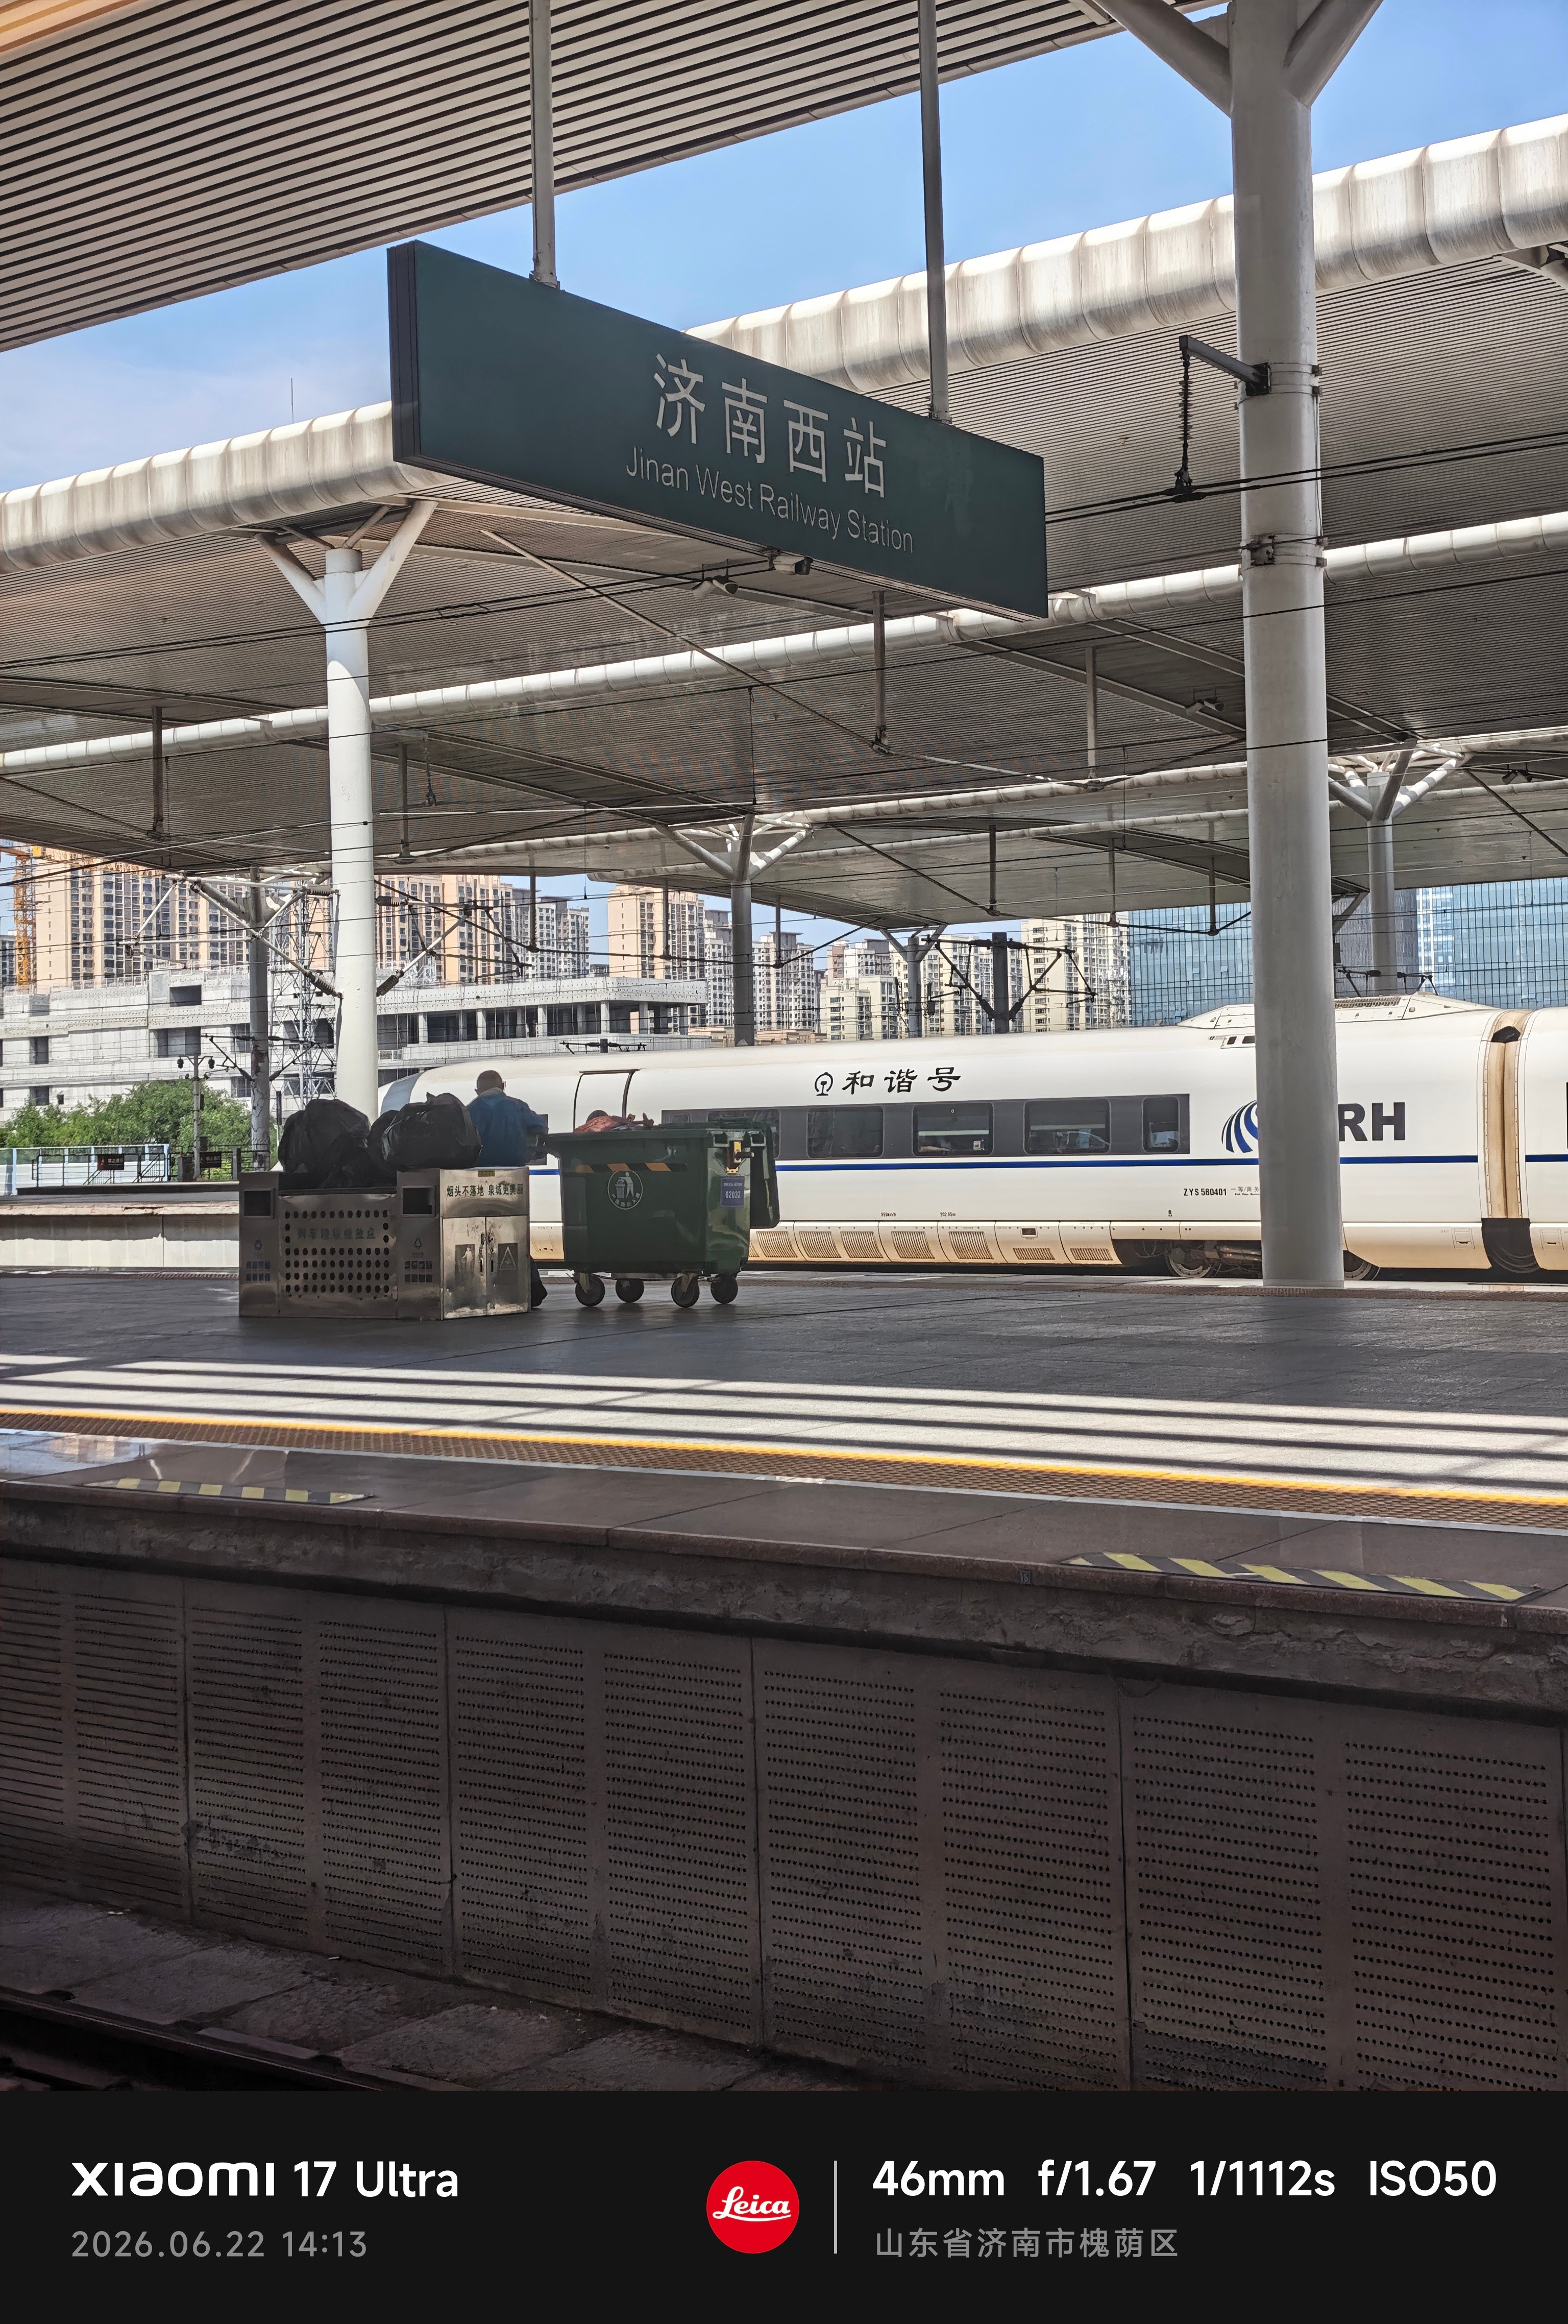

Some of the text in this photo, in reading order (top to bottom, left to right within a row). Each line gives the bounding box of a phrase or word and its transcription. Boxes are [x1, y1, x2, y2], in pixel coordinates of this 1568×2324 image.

[653, 353, 887, 498] 济南西站
[626, 446, 914, 553] Jinan West Railway Station
[842, 1067, 961, 1095] 和谐号
[1338, 1102, 1406, 1142] RH
[447, 1184, 484, 1197] 烟头不落地
[1184, 1188, 1227, 1196] ZYS 580401
